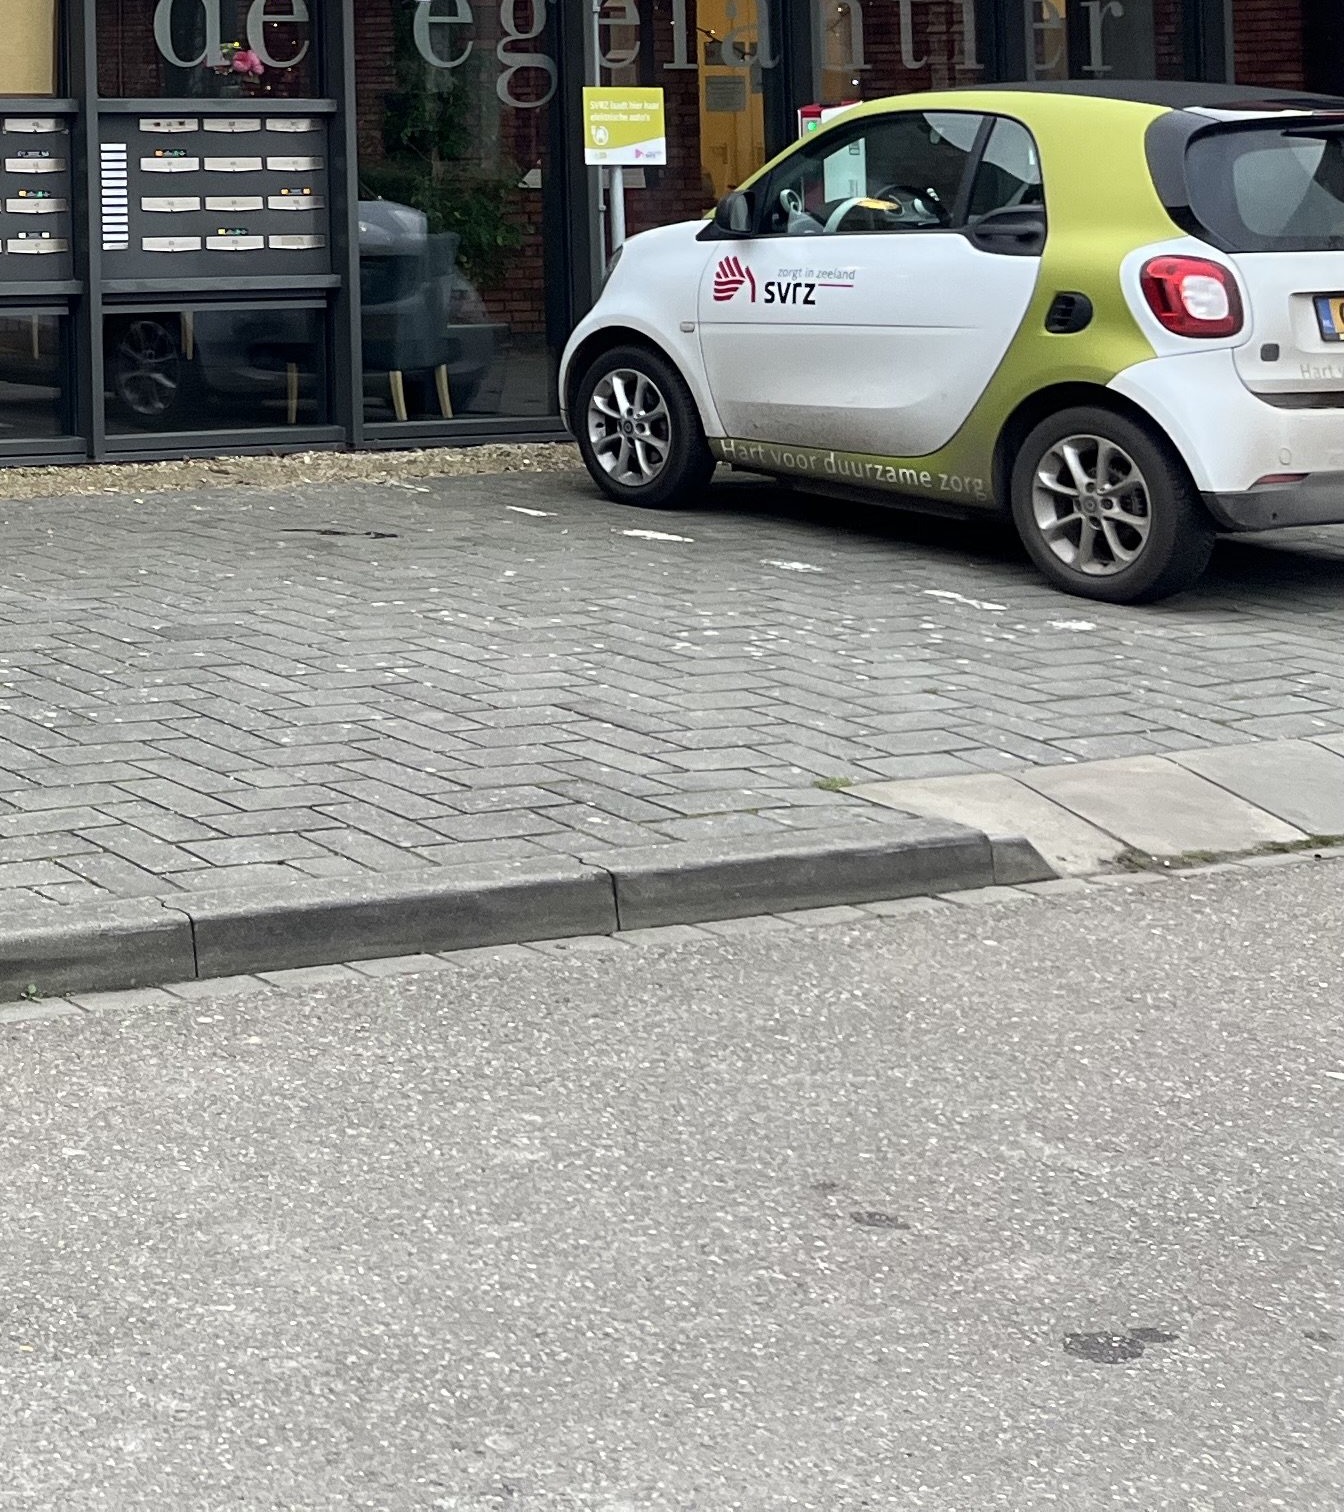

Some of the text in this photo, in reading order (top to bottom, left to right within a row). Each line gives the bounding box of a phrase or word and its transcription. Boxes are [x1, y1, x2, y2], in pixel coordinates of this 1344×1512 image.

[778, 267, 856, 281] zorgt in zeeland
[1299, 363, 1333, 379] Hart
[720, 439, 987, 501] Hart voor duurzame zorg
